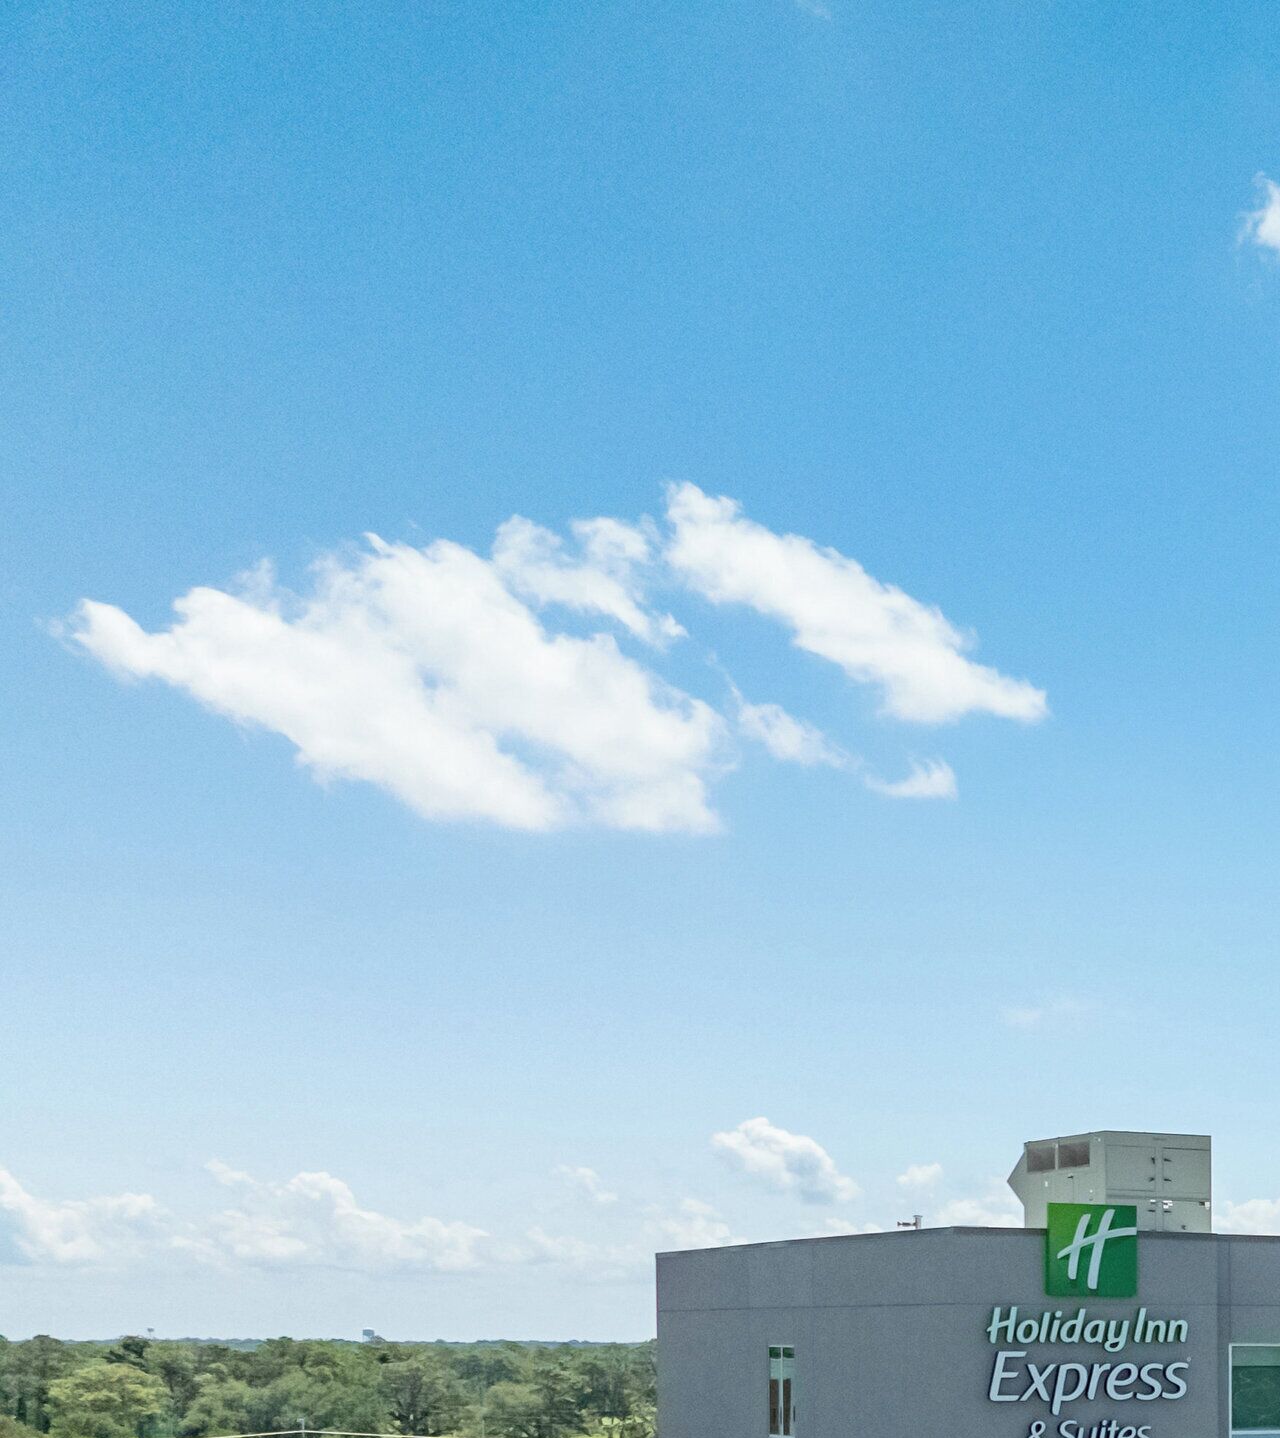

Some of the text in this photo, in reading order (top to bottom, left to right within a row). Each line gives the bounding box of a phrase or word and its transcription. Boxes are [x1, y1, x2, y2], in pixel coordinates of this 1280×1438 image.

[1056, 1208, 1137, 1290] H
[986, 1306, 1188, 1353] Holiday Inn
[988, 1350, 1190, 1416] Express
